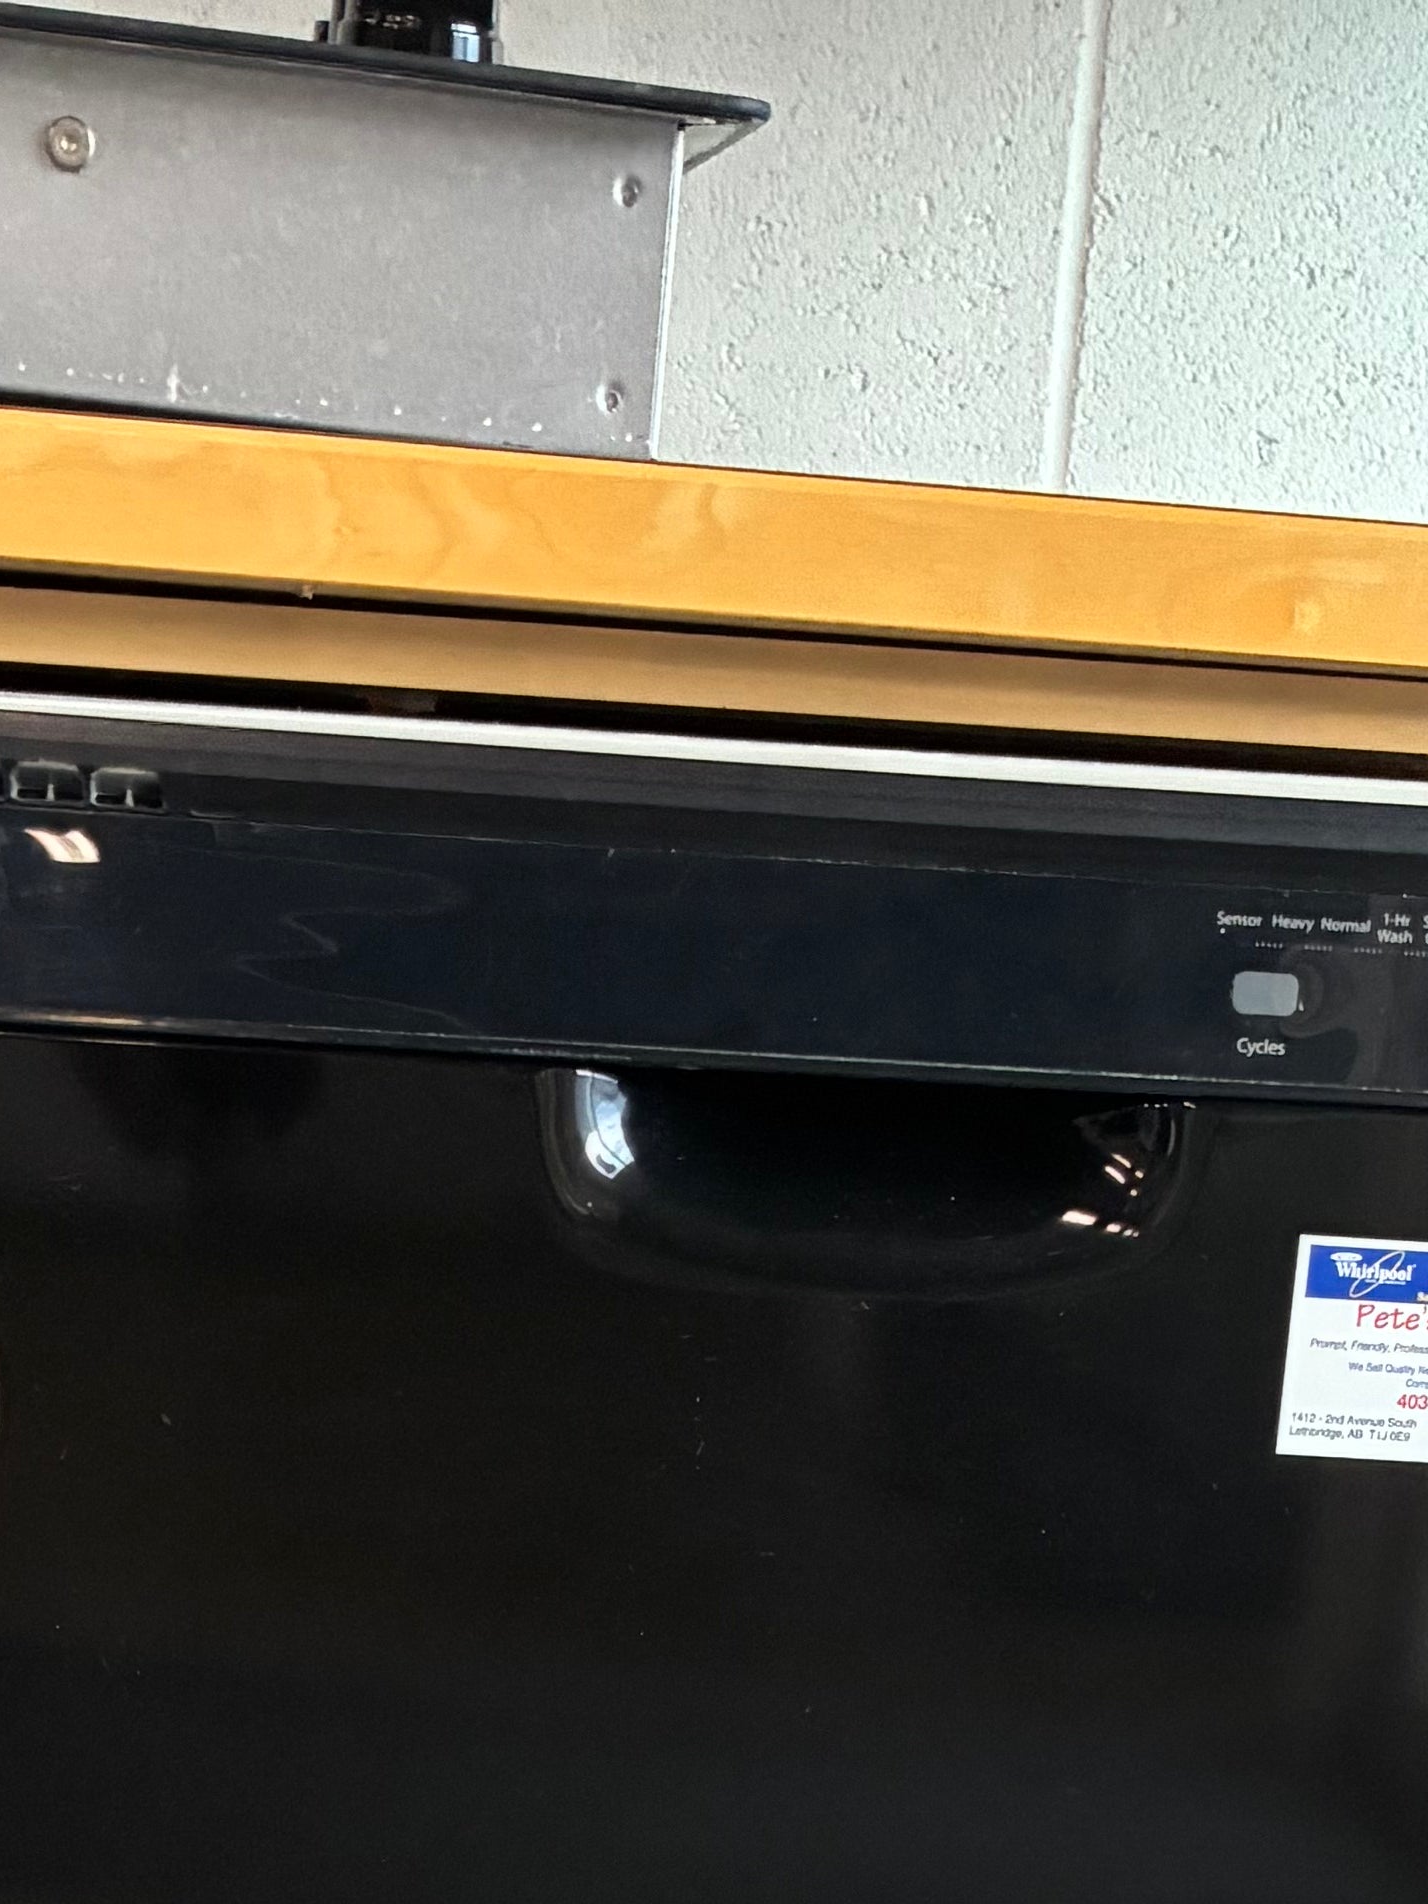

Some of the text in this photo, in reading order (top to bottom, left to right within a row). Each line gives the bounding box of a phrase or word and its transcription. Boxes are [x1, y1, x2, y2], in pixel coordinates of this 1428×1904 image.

[1217, 911, 1263, 927] Sensor
[1272, 914, 1315, 934] Heavy
[1321, 917, 1372, 933] Normal
[1383, 913, 1412, 927] 1-Hr
[1377, 929, 1413, 944] Wash
[1236, 1037, 1286, 1058] Cycles
[1335, 1260, 1416, 1285] Whirlpool
[1348, 1361, 1364, 1372] We
[1366, 1362, 1384, 1373] Sell
[1385, 1364, 1416, 1376] Quality
[1292, 1412, 1317, 1424] 1412
[1325, 1414, 1345, 1426] 2nd
[1347, 1416, 1386, 1428] Avenue
[1387, 1417, 1418, 1430] South
[1347, 1429, 1364, 1440] AB
